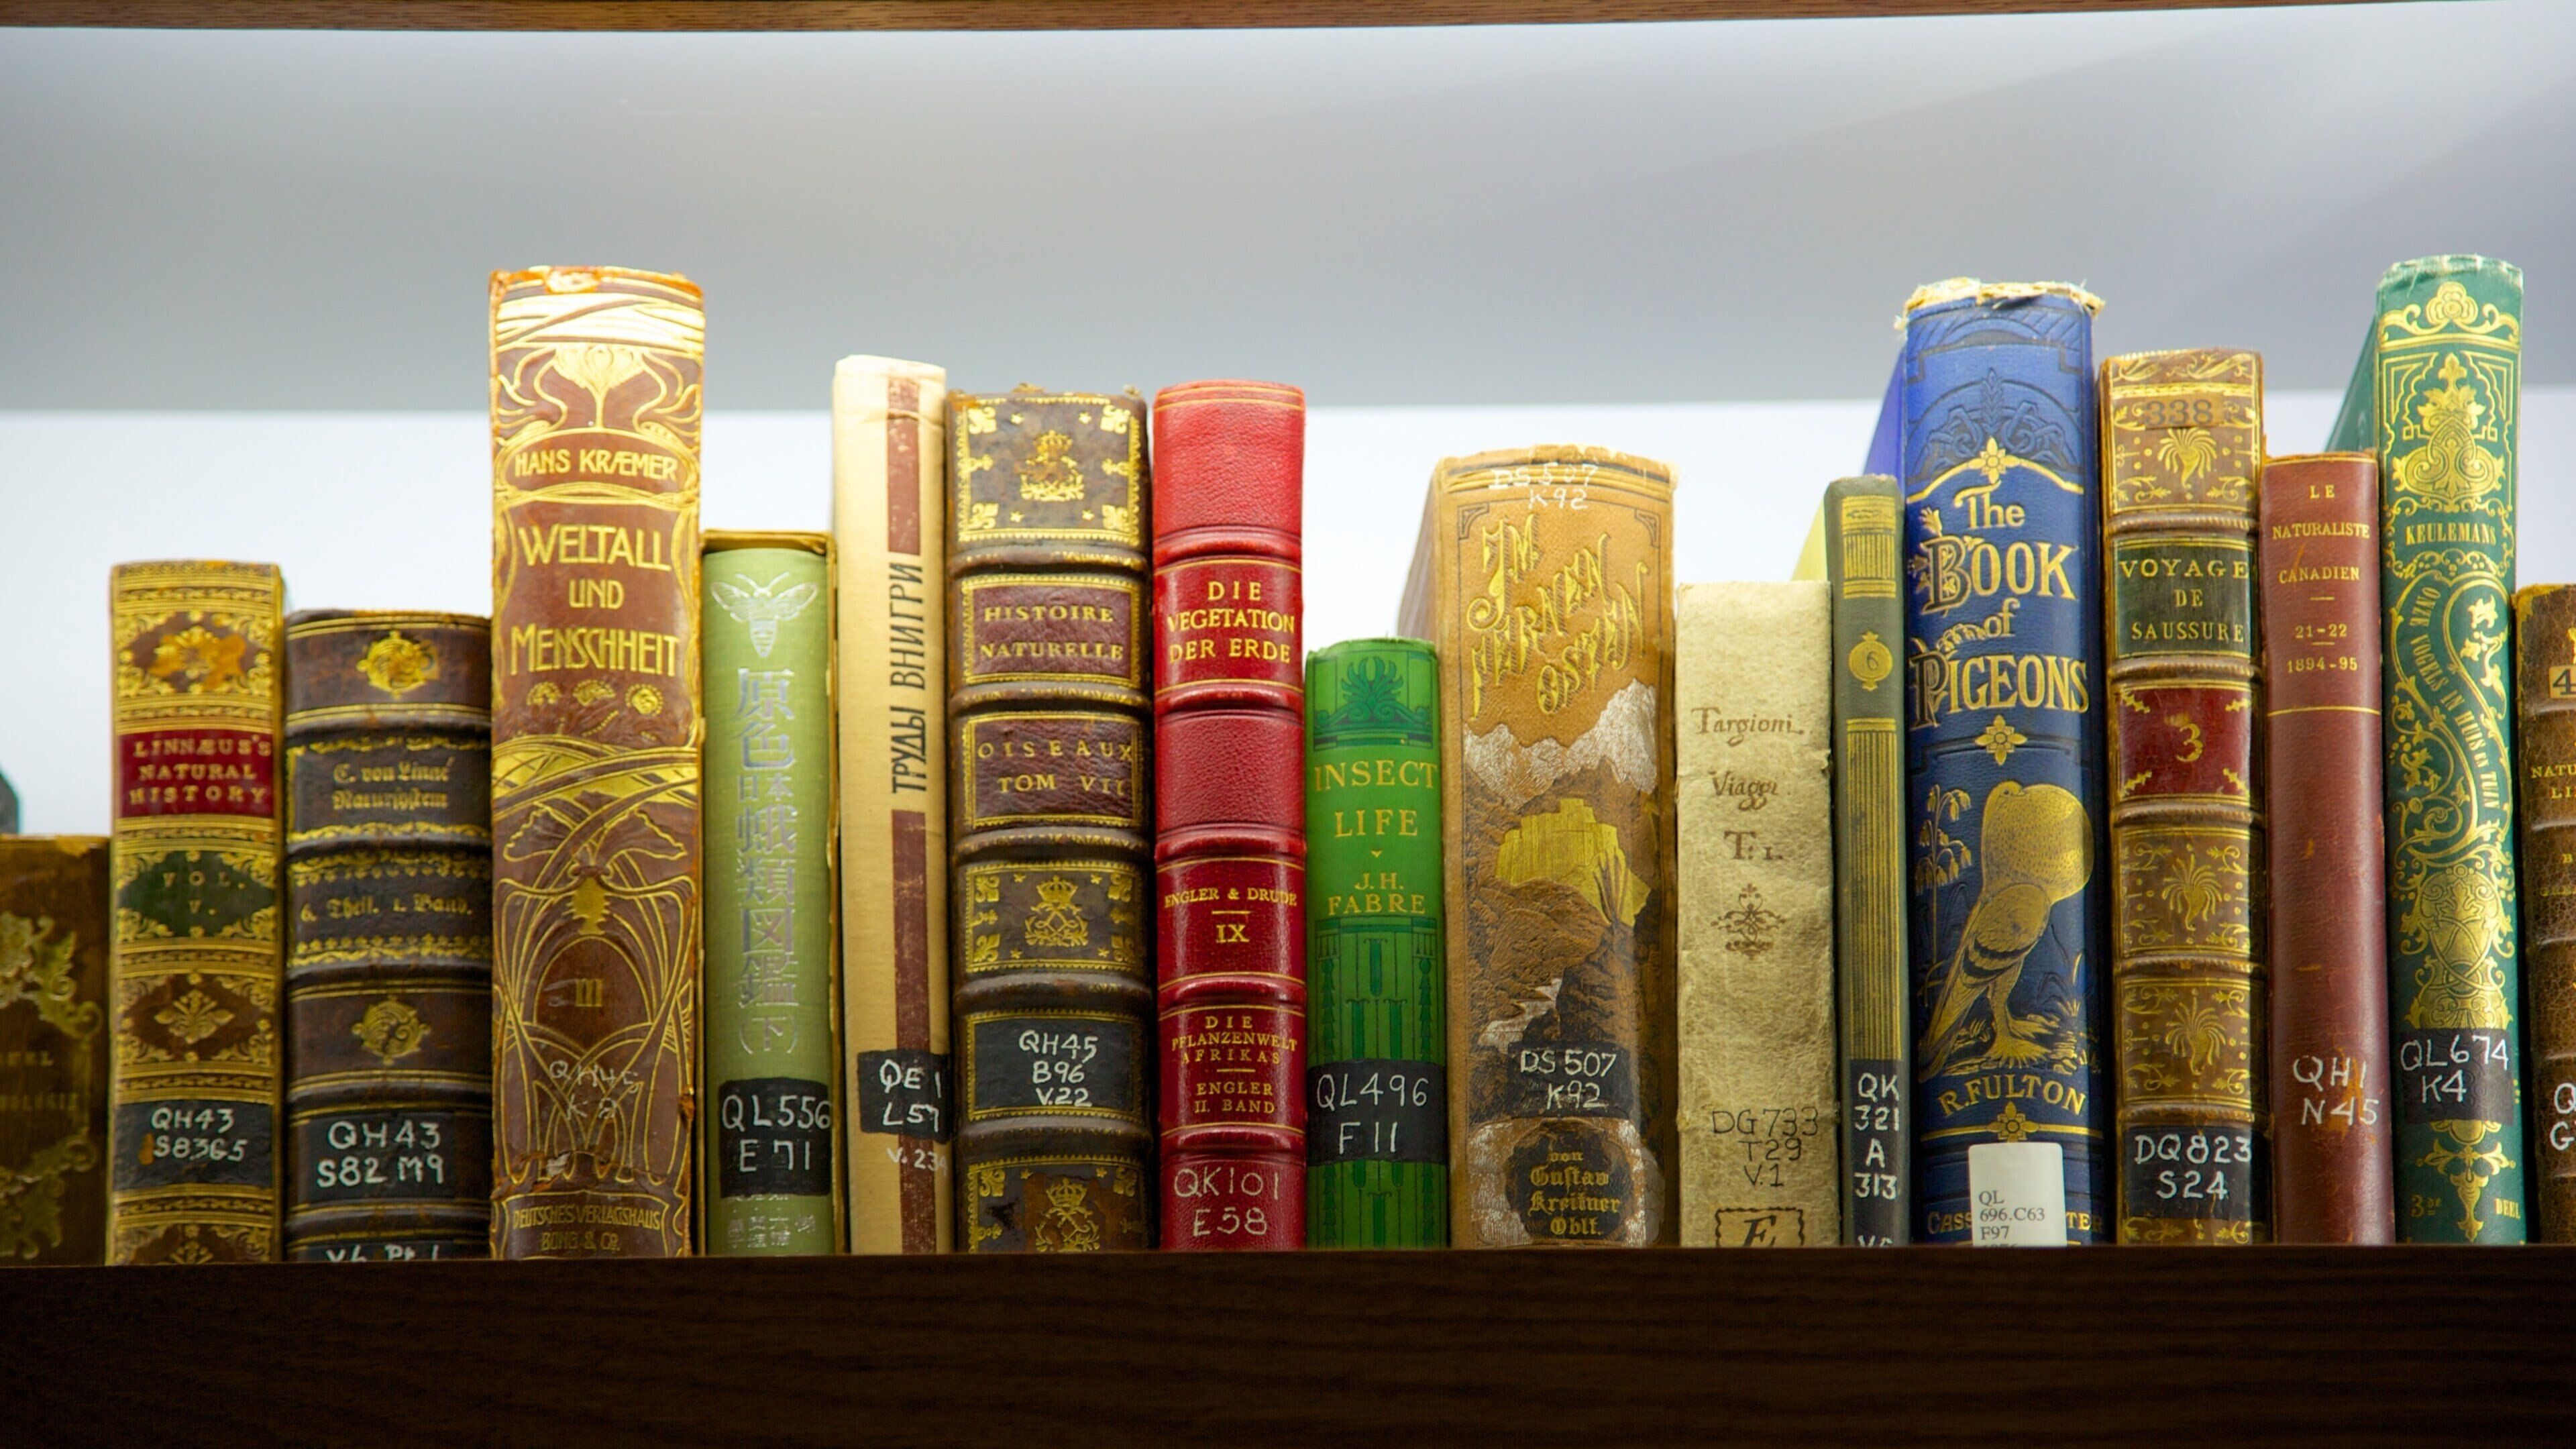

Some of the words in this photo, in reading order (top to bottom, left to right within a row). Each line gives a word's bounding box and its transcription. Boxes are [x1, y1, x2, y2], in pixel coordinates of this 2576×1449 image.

[2147, 399, 2214, 426] 338
[515, 448, 571, 477] HANS
[579, 449, 678, 482] KRÆMER
[2310, 484, 2335, 498] LE
[1953, 480, 2025, 529] The
[2272, 523, 2370, 540] NATURALISTE
[2405, 521, 2496, 546] KEULEMANS
[518, 523, 672, 572] WELTALL
[2118, 558, 2250, 580] VOYAGE
[2279, 567, 2360, 584] CANADIEN
[569, 578, 625, 610] UND
[1208, 581, 1261, 601] DIE
[2174, 588, 2203, 607] DE
[888, 561, 926, 691] ВНИГРИ
[984, 605, 1114, 623] HISTOIRE
[1167, 608, 1295, 634] VEGETATION
[1982, 597, 2021, 637] of
[2131, 621, 2245, 644] SAUSSURE
[2295, 623, 2348, 639] 21-22
[510, 623, 680, 678] MENSCHHEIT
[979, 641, 1124, 660] NATURELLE
[1170, 639, 1216, 663] DER
[1229, 638, 1291, 664] ERDE
[2287, 656, 2358, 674] 1894-95
[890, 705, 927, 794] ТРУДЫ
[977, 739, 1132, 762] OISEAUX
[2176, 722, 2204, 763] 3
[139, 764, 257, 780] NATURAL
[998, 774, 1057, 793] TOM
[1314, 759, 1438, 792] INSECT
[129, 786, 267, 804] HISTORY
[1334, 809, 1418, 837] LIFE
[163, 872, 246, 890] VOL.
[1165, 888, 1220, 908] ENGLER
[1228, 888, 1240, 900] &
[1247, 888, 1297, 906] DRUDE
[1328, 894, 1426, 916] FABRE
[1216, 924, 1250, 943] IX
[576, 977, 603, 1007] III
[1205, 1016, 1252, 1029] DIE
[1018, 1030, 1099, 1063] QH45
[1172, 1030, 1297, 1051] PFLANZENWELT
[2400, 1034, 2510, 1071] QL674
[1181, 1049, 1280, 1065] AFRIKAS
[1032, 1061, 1085, 1084] B96
[1196, 1081, 1273, 1096] ENGLER
[1317, 1073, 1429, 1112] QL496
[1546, 1080, 1609, 1110] K92
[1858, 1072, 1900, 1102] QK
[2422, 1069, 2467, 1104] K4
[722, 1094, 831, 1132] QL556
[1222, 1099, 1275, 1114] BAND
[1854, 1105, 1900, 1132] 321
[2301, 1096, 2380, 1126] N45
[151, 1107, 235, 1133] QH43
[328, 1120, 441, 1150] QH43
[1737, 1138, 1803, 1162] T29
[1866, 1138, 1886, 1168] A
[2134, 1133, 2253, 1165] DQ823
[1854, 1172, 1898, 1200] 313
[2157, 1170, 2229, 1200] S24
[1978, 1191, 2004, 1207] QL
[1193, 1207, 1267, 1237] E58
[1979, 1208, 2045, 1222] 696.C63
[1980, 1226, 2010, 1240] F97
